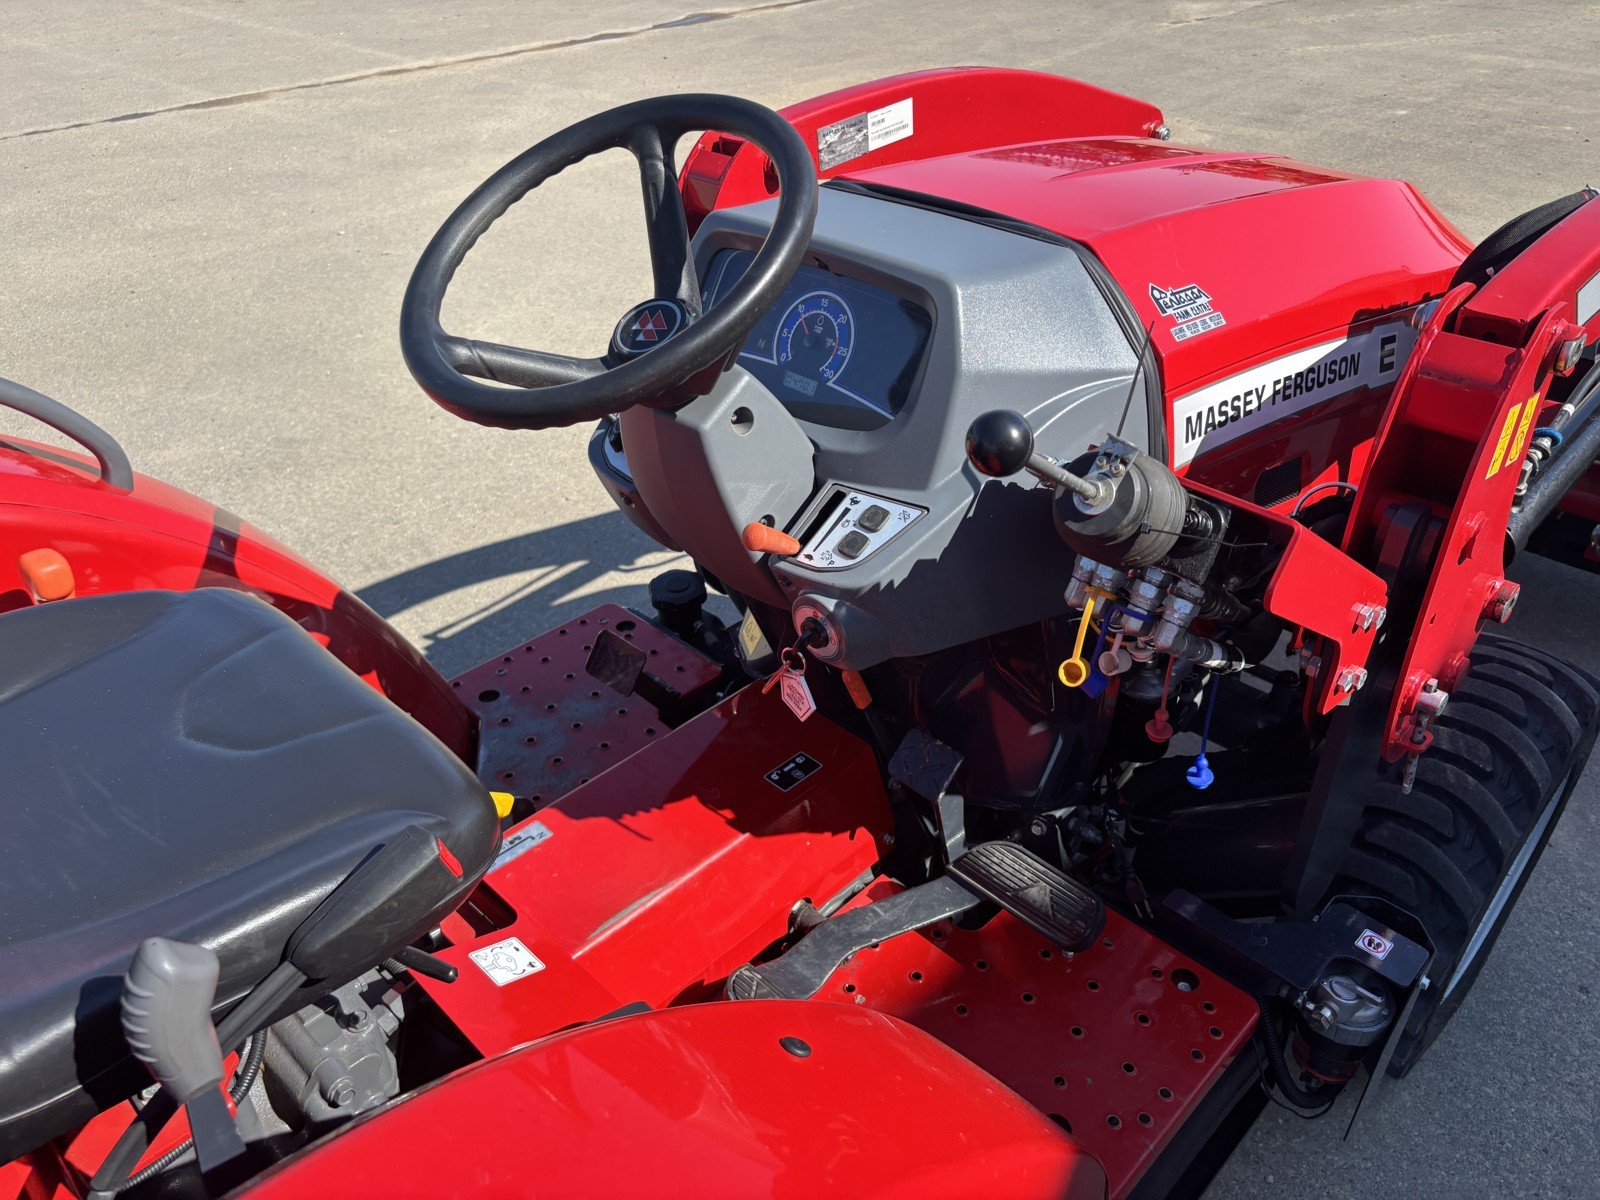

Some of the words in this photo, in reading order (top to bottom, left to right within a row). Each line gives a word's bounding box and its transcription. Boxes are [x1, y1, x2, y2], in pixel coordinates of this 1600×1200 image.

[821, 298, 829, 307] 15
[797, 304, 805, 313] 10
[837, 314, 847, 324] 20
[781, 328, 788, 337] 5
[837, 346, 848, 357] 25
[780, 353, 786, 361] 0
[823, 368, 834, 379] 30
[1184, 384, 1266, 444] MASSEY
[1271, 351, 1361, 406] FERGUSON
[1379, 334, 1396, 374] E
